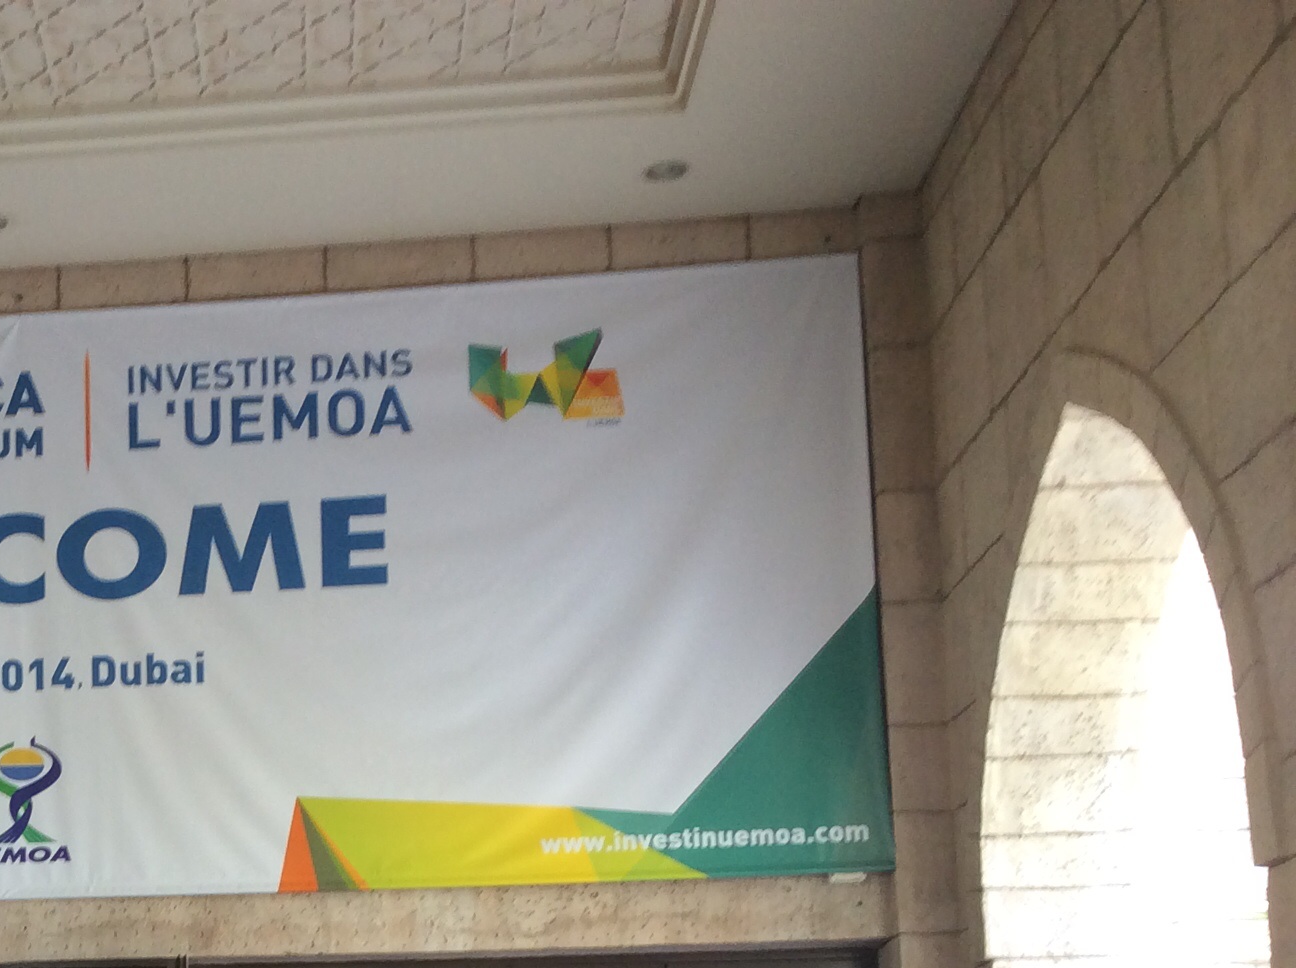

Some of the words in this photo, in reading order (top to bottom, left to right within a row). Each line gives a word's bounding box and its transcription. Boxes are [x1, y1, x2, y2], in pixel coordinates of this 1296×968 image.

[127, 355, 296, 395] INVESTIR
[311, 347, 413, 382] DANS
[127, 385, 413, 451] L'UEMOA
[91, 650, 205, 688] Dubai
[540, 822, 870, 854] www.investinuemoa.com
